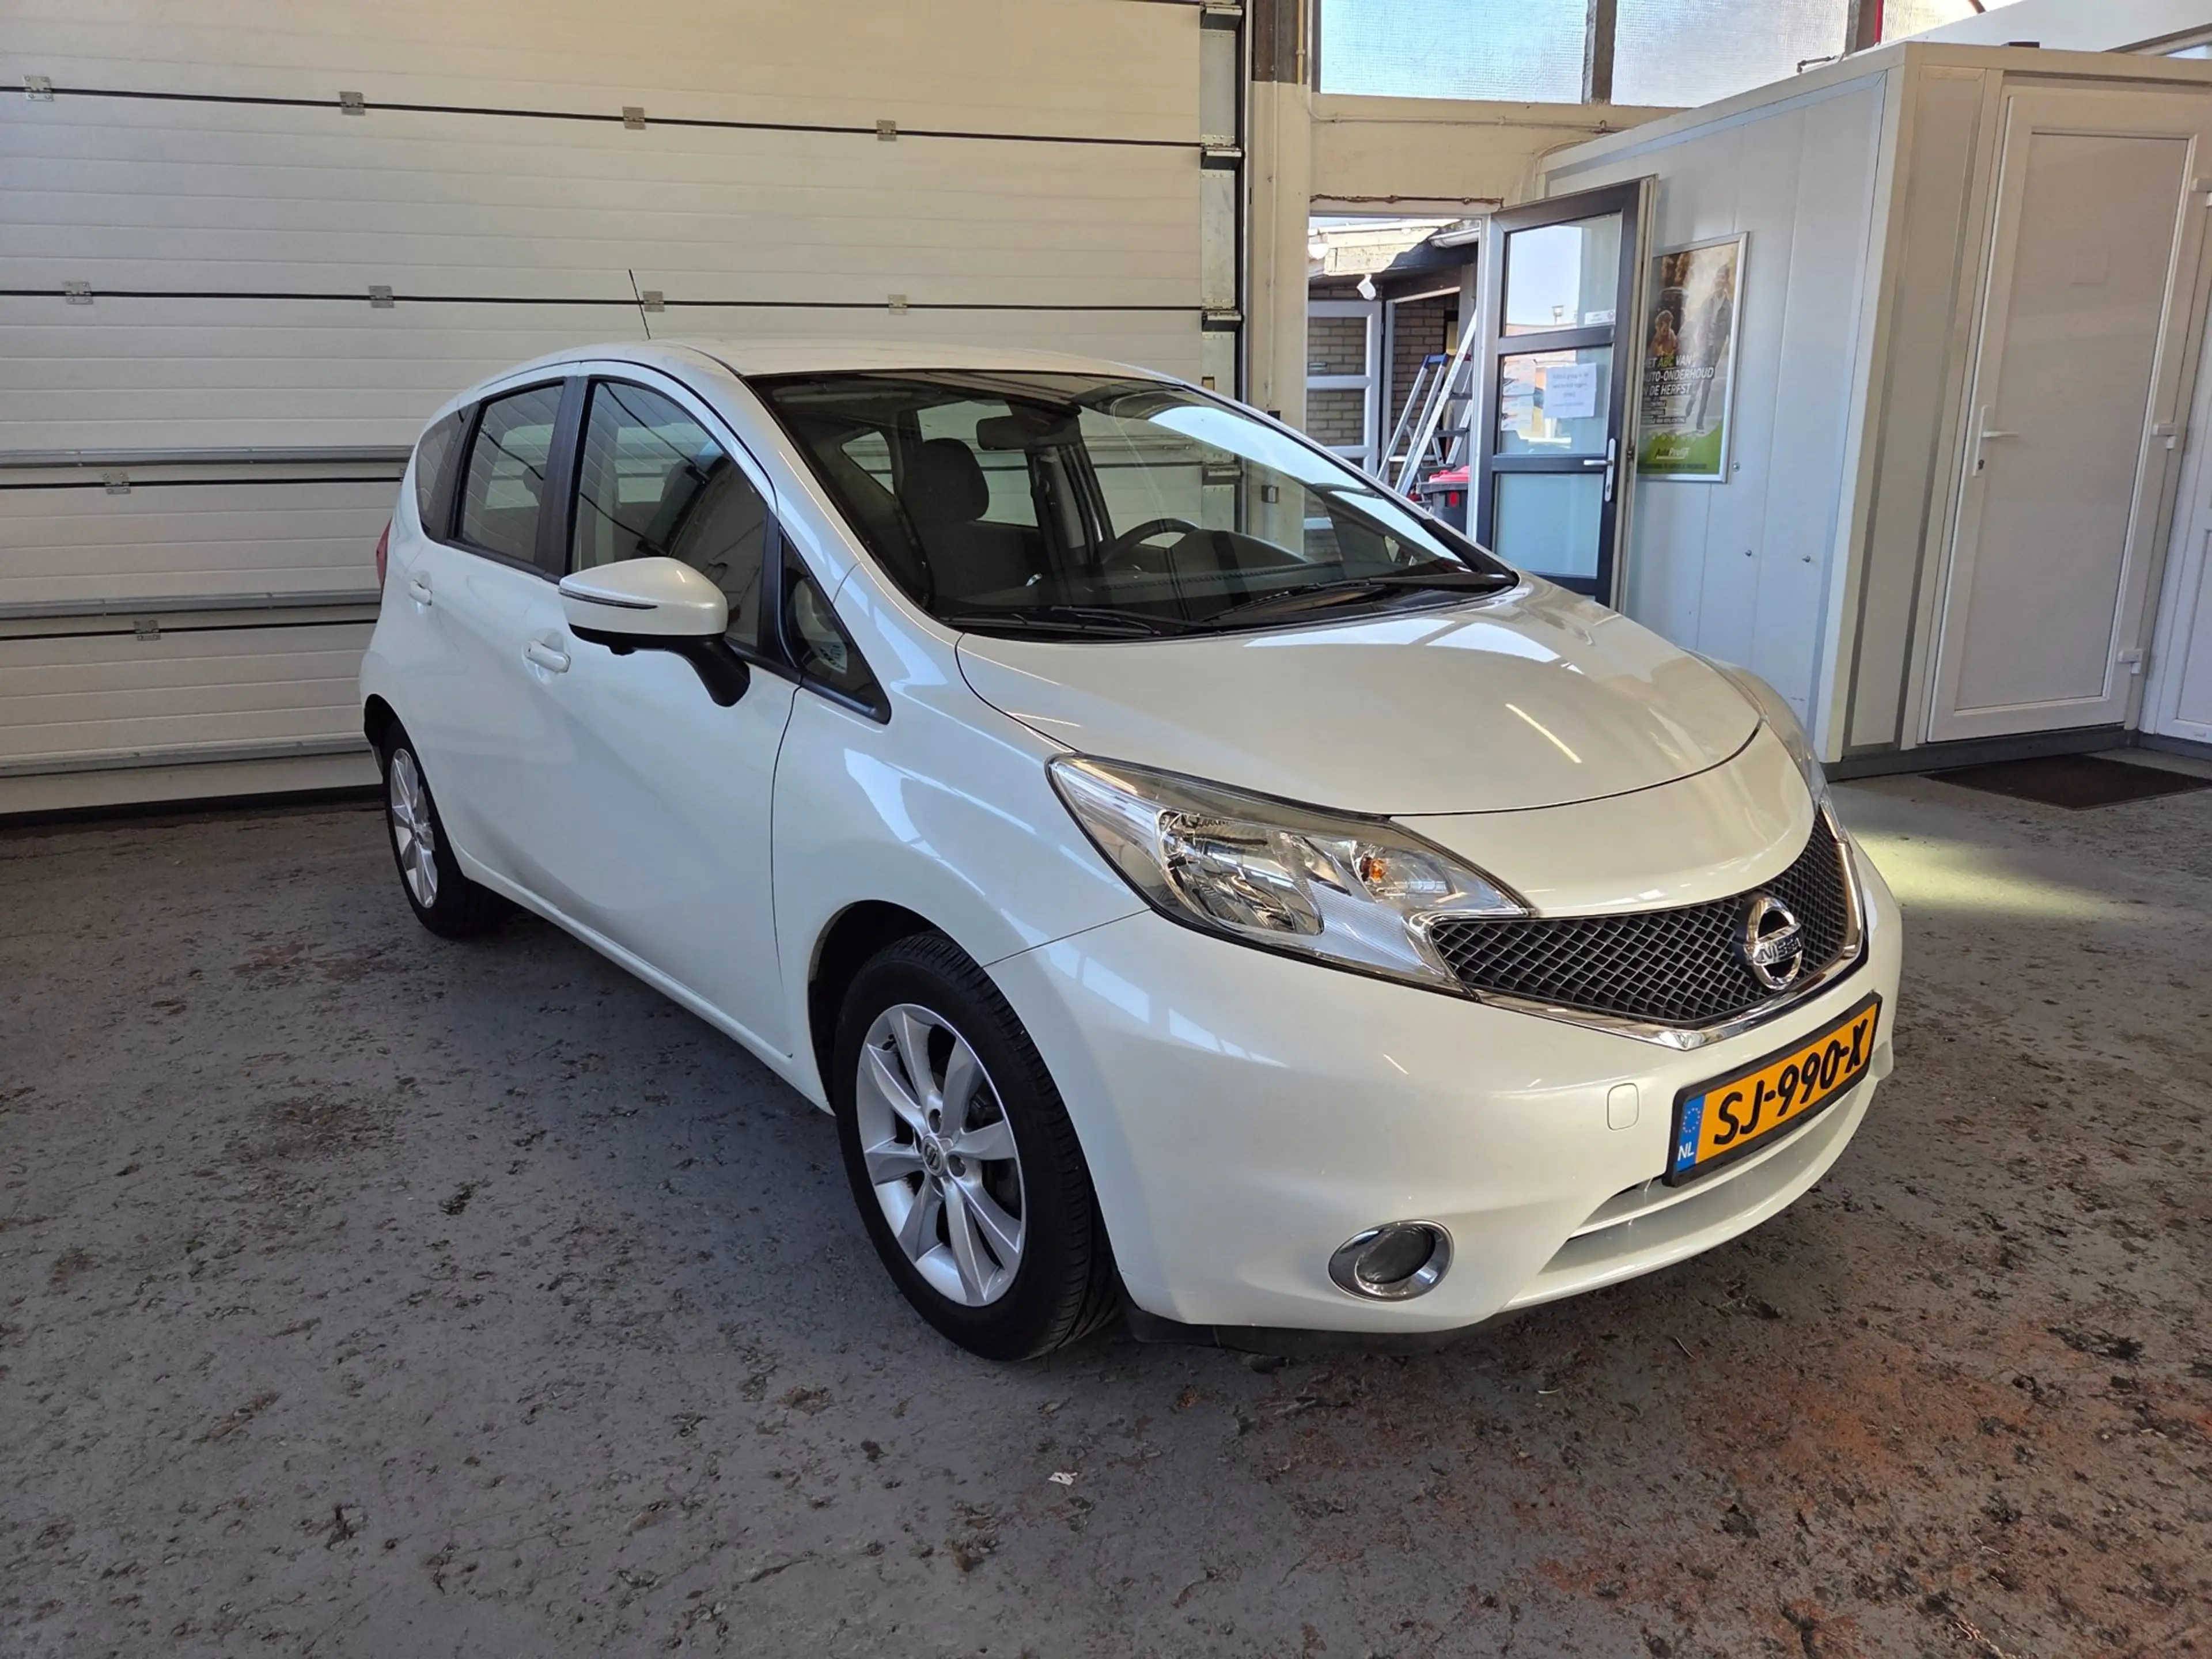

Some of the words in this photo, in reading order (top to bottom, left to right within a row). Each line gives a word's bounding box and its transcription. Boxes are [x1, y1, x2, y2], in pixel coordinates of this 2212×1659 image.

[1676, 354, 1692, 366] VAN
[1645, 367, 1714, 382] UTO-ONDERHOUD
[1650, 384, 1660, 396] DE
[1661, 383, 1691, 395] HERFST
[1714, 1018, 1869, 1145] SJ-990-X
[1677, 1143, 1695, 1161] NL
